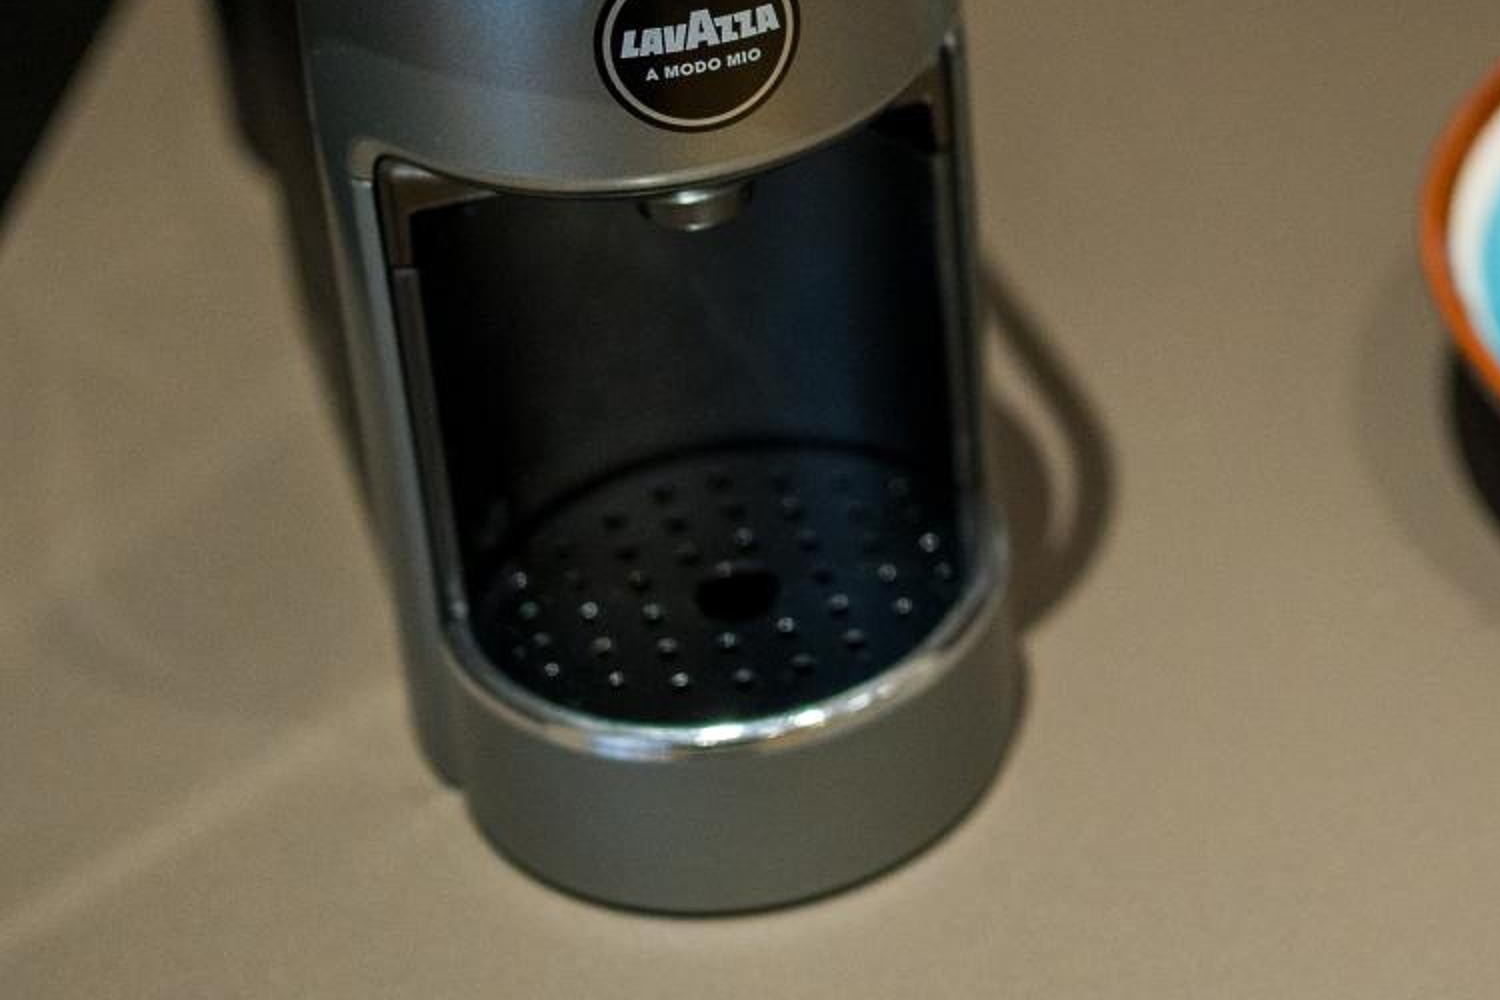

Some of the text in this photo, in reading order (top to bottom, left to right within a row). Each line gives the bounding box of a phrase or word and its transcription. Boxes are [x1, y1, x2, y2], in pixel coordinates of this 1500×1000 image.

[620, 3, 781, 59] LAVAZZA
[646, 47, 761, 81] A MODO MIO
